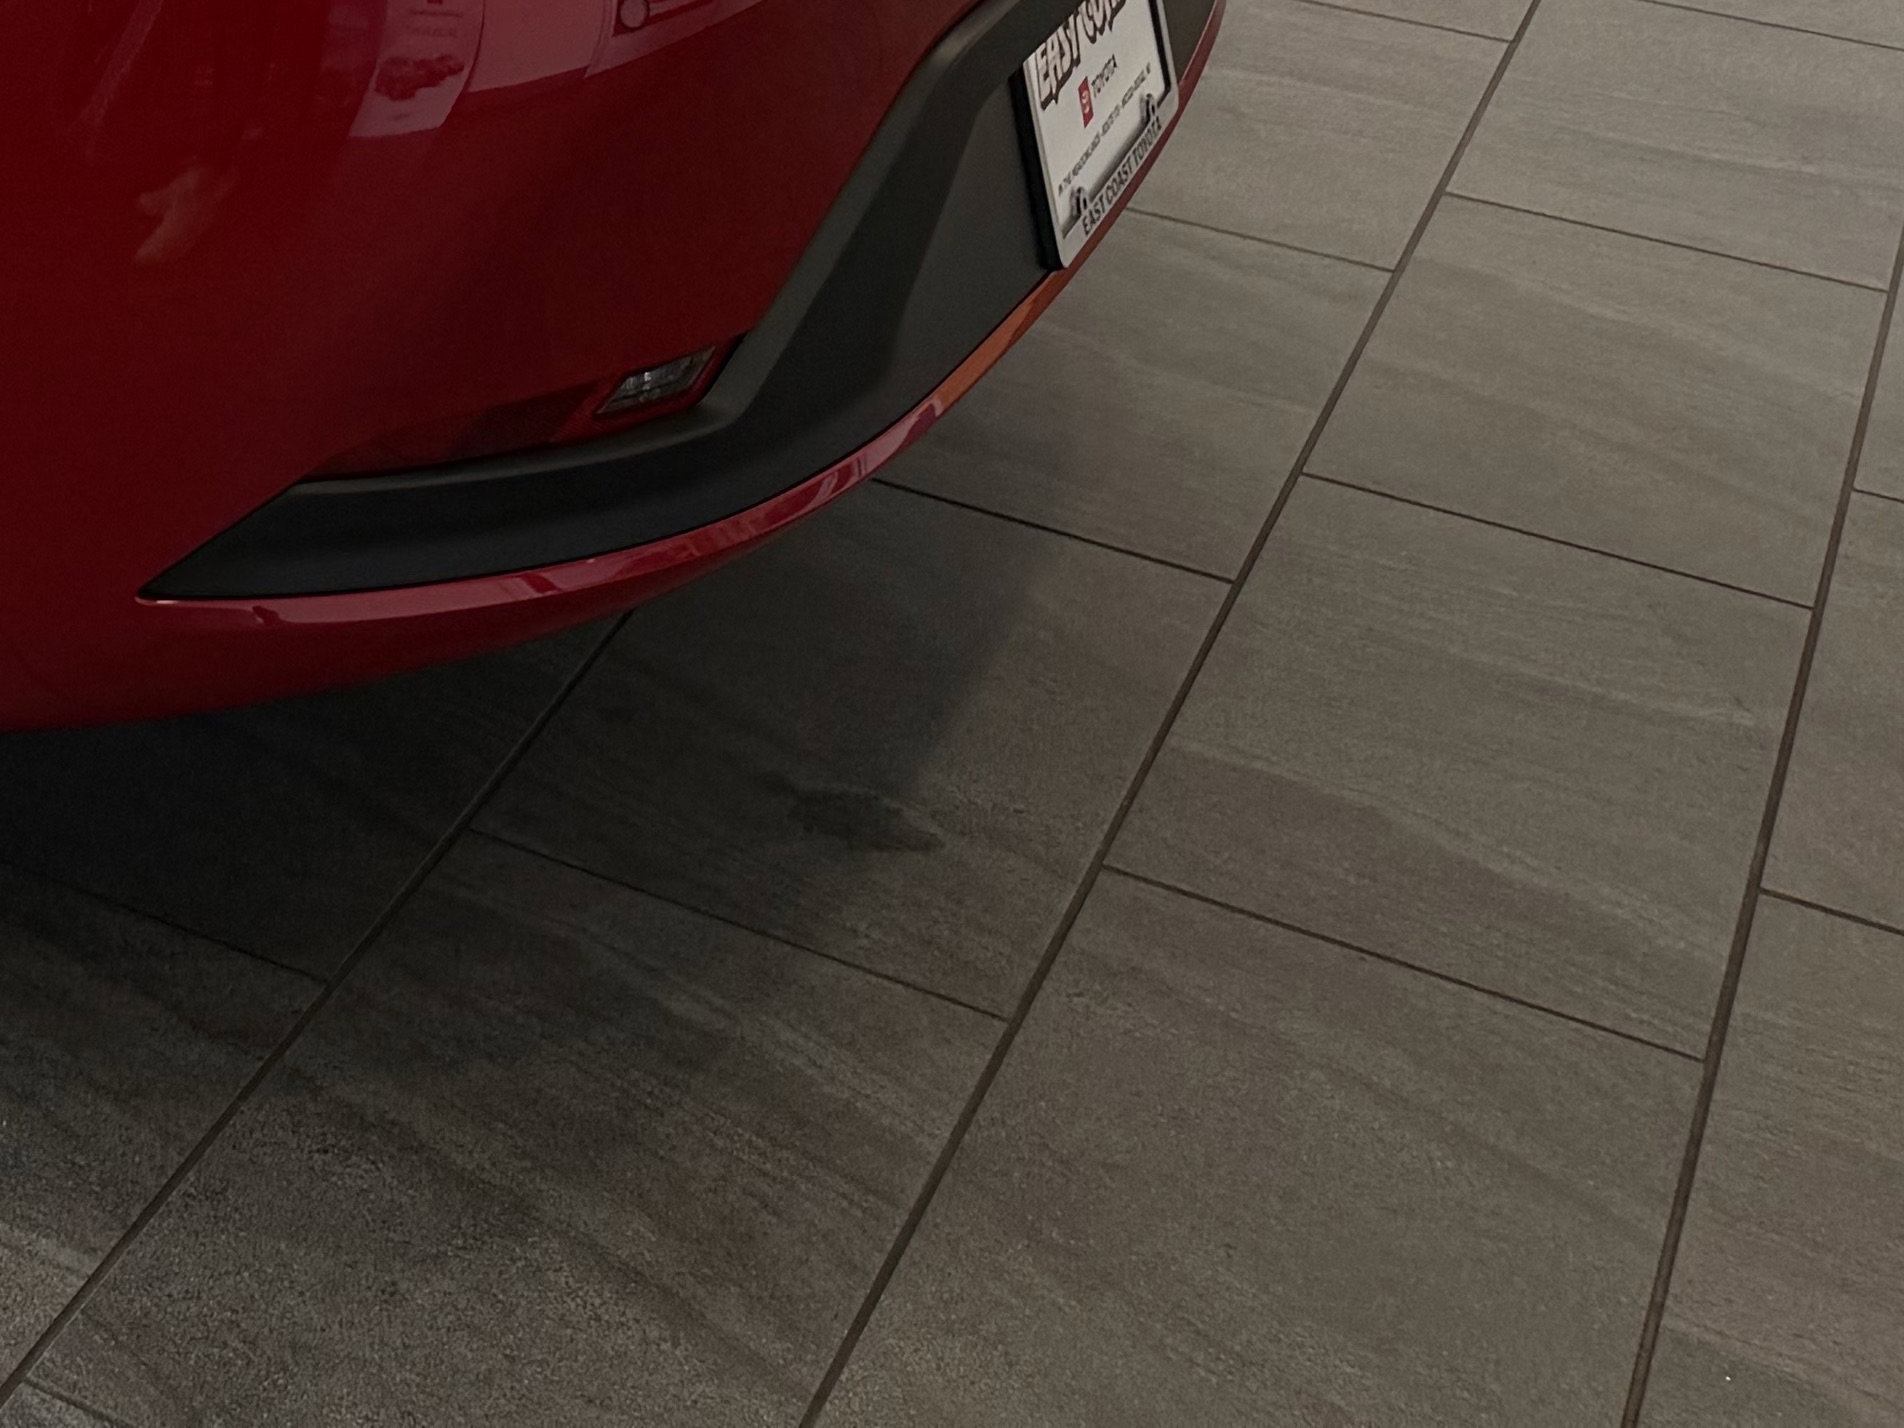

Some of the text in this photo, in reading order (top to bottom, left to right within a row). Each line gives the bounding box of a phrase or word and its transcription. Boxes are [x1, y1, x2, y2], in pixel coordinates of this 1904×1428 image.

[1082, 199, 1106, 236] EAST
[1105, 159, 1133, 206] COAST
[1134, 115, 1162, 170] TOYOTA
